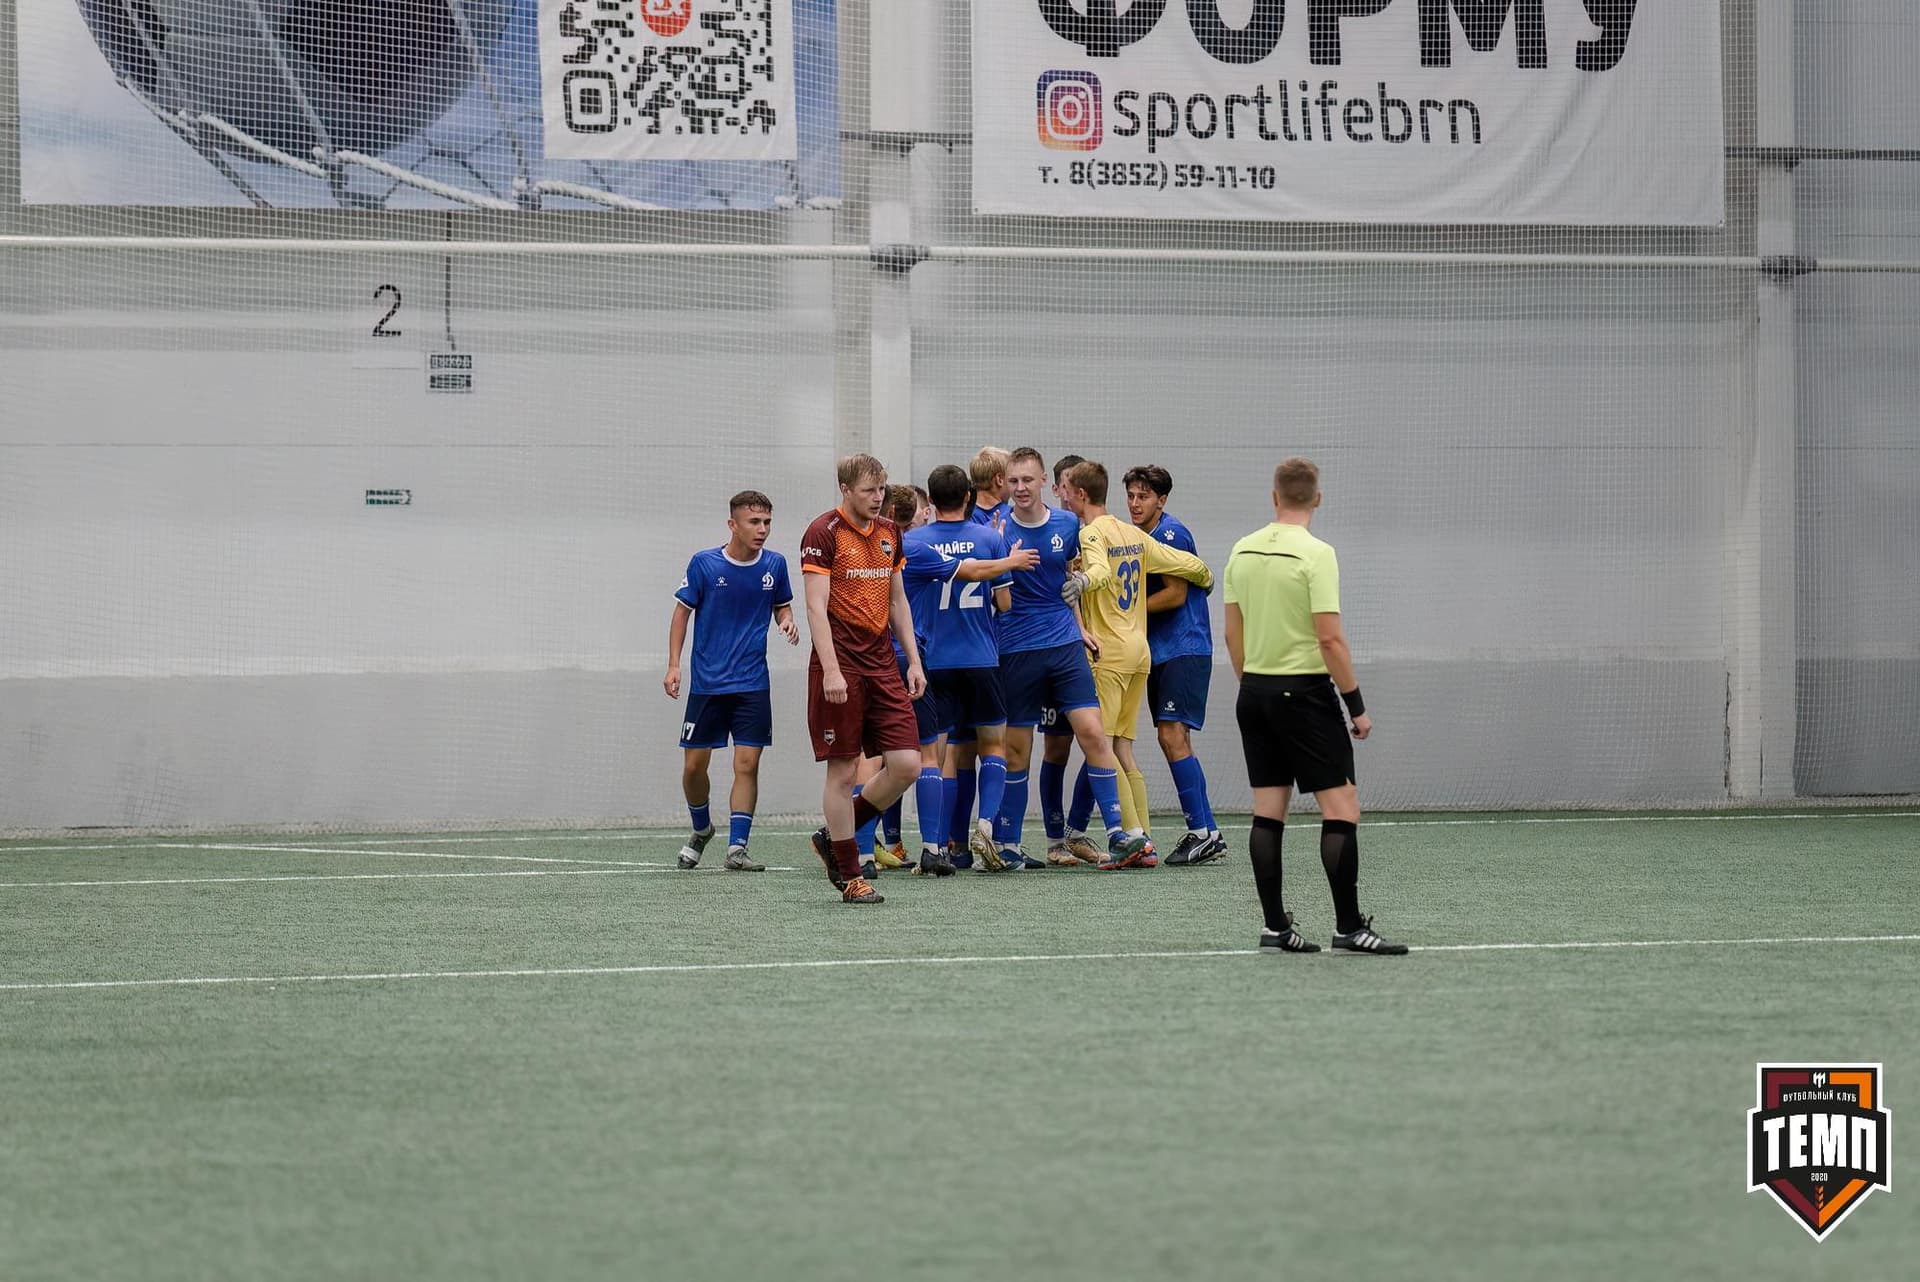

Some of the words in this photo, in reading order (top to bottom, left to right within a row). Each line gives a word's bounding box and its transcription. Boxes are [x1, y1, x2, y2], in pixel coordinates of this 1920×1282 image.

[1112, 79, 1482, 153] sportlifebrn
[1069, 158, 1168, 191] 8(3852)
[1174, 164, 1276, 190] 59-11-10
[372, 284, 402, 337] 2
[934, 541, 975, 554] МАЙЕР
[681, 721, 696, 741] 17
